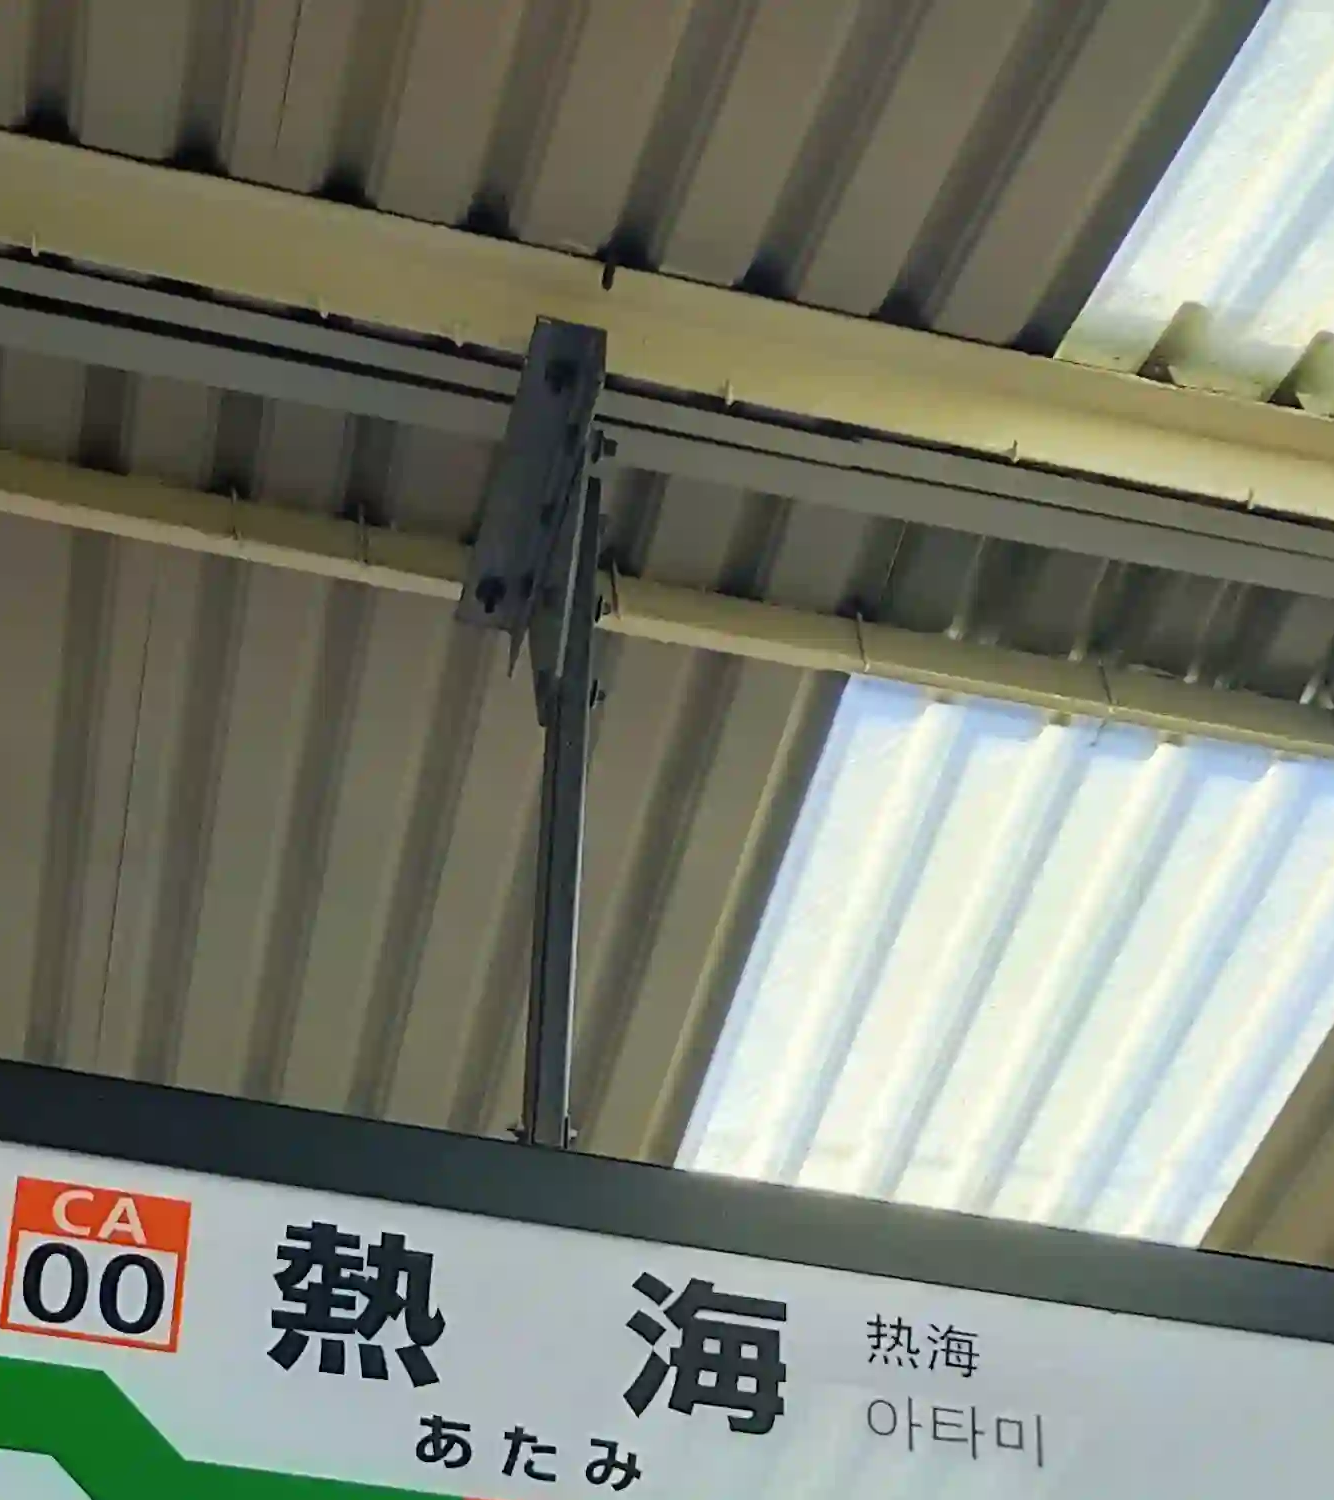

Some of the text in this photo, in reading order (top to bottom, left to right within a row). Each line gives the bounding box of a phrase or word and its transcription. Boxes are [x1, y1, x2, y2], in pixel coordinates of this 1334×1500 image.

[53, 1190, 146, 1244] CA
[23, 1243, 164, 1334] 00
[267, 1222, 787, 1436] 熱海
[867, 1314, 979, 1378] 热海
[416, 1415, 641, 1491] あたみ
[867, 1397, 1044, 1468] 아타미
